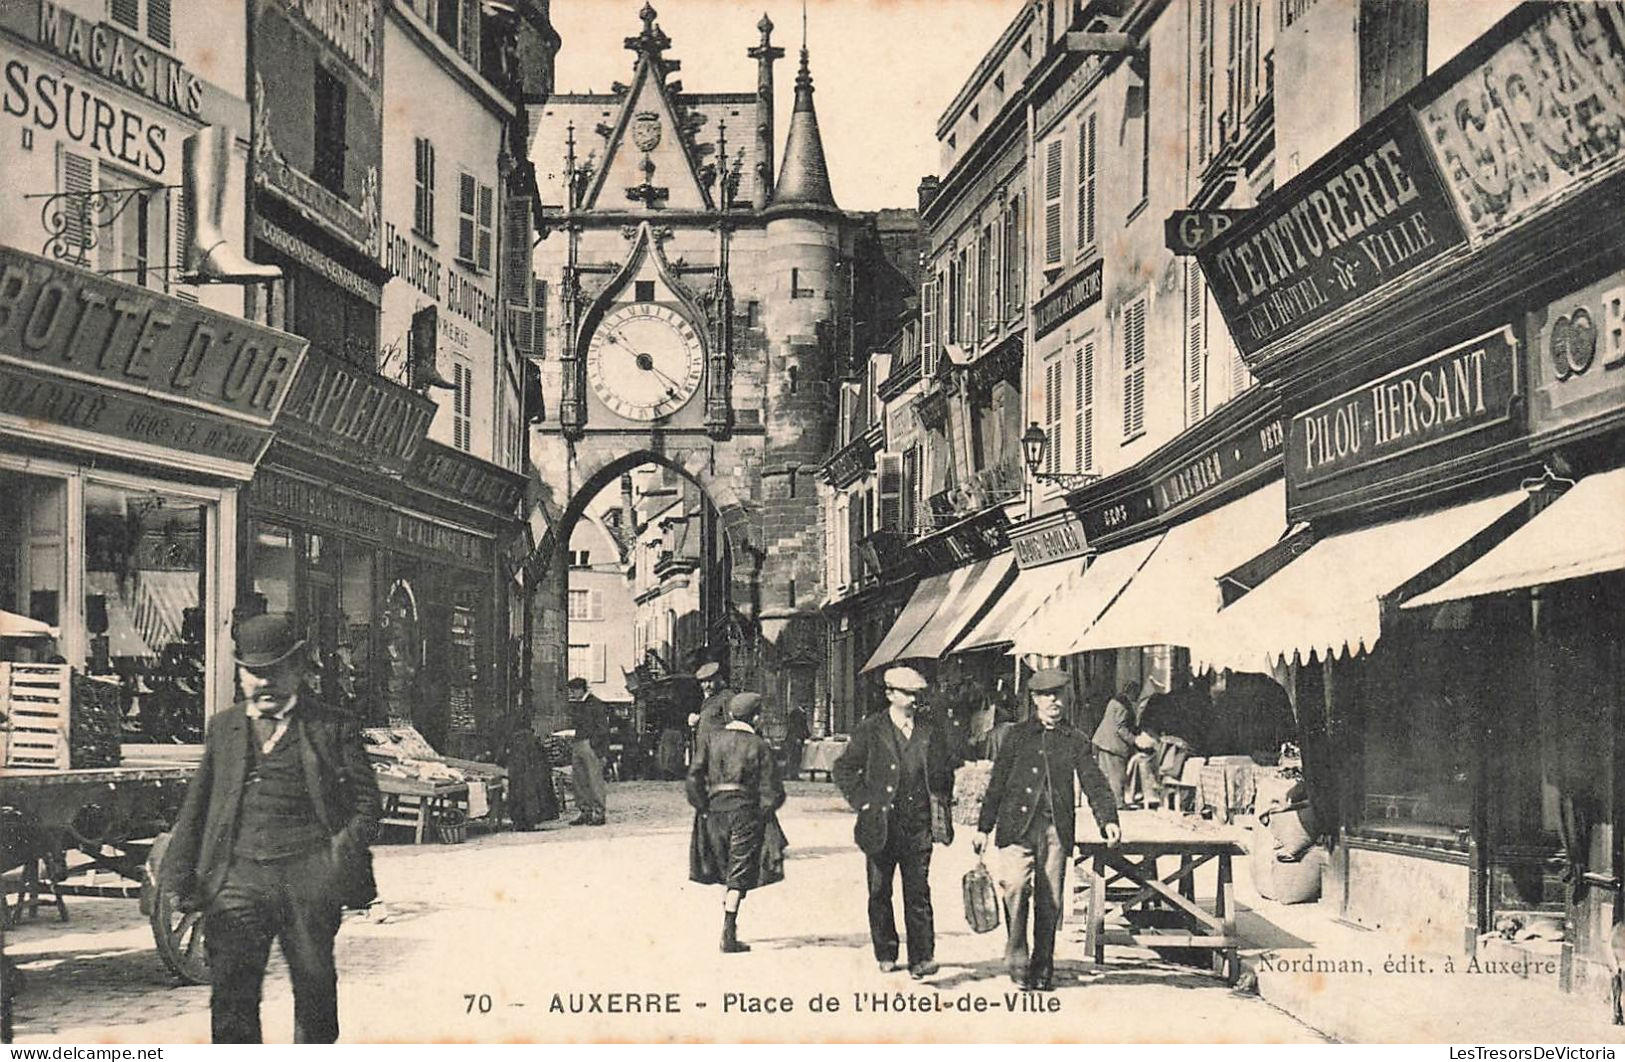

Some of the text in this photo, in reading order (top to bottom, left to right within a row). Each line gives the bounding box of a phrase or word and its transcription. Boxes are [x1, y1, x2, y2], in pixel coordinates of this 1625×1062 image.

[38, 4, 203, 116] MAGASINS
[2, 59, 167, 177] SSURES
[384, 221, 495, 336] HORLOGERIE BIJOUTERIE
[1215, 138, 1422, 305] TEINTURERIE
[1360, 210, 1436, 277] VILLE
[172, 318, 292, 416] D'OR
[1304, 348, 1488, 470] PILOU HERSANT
